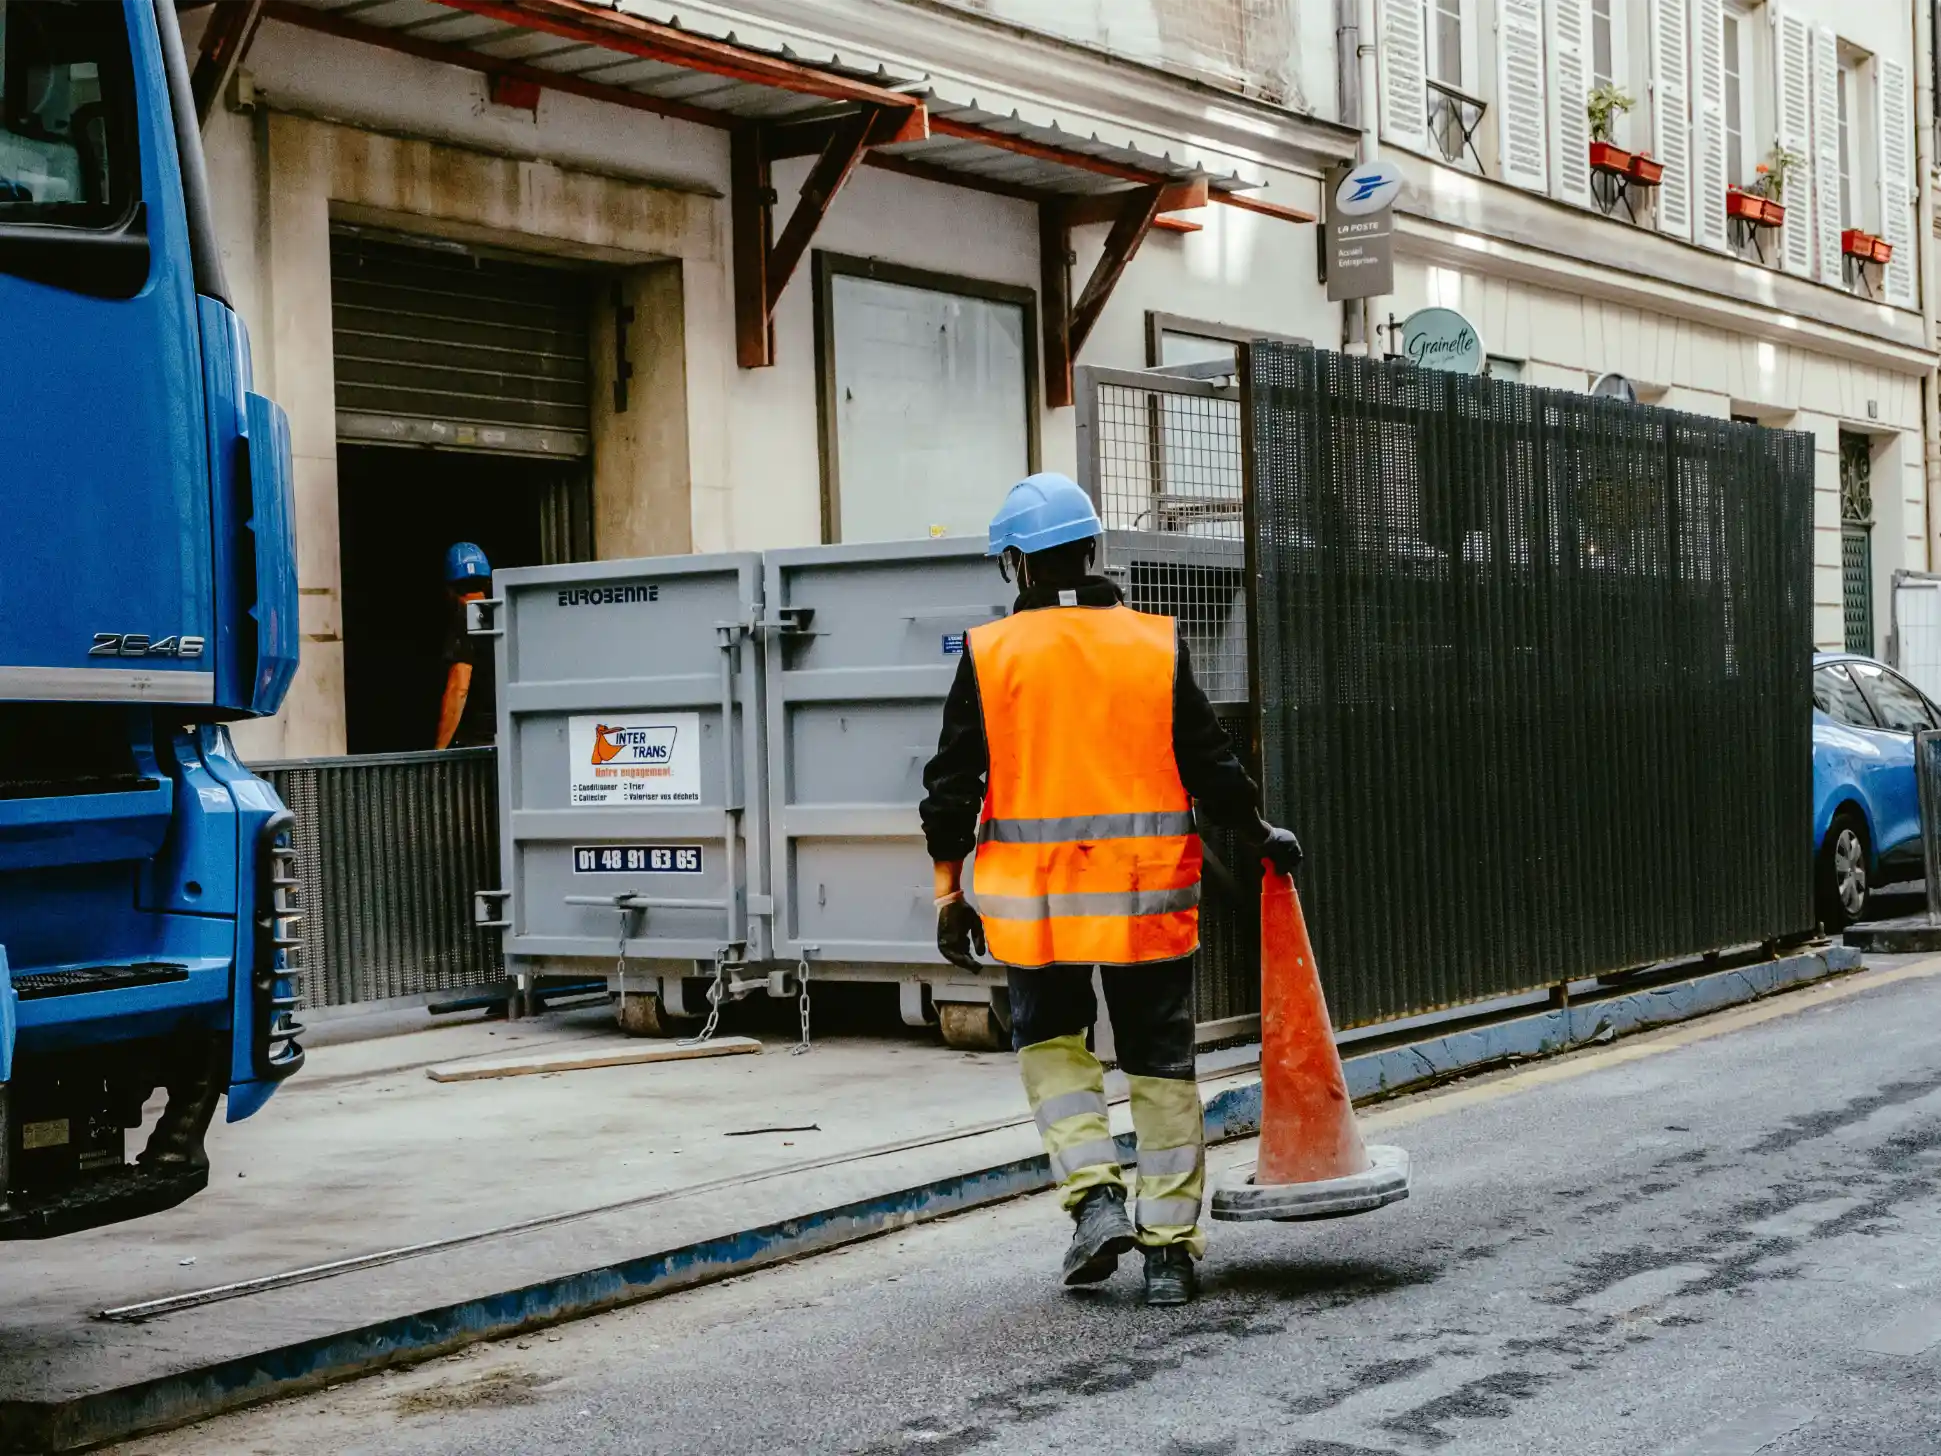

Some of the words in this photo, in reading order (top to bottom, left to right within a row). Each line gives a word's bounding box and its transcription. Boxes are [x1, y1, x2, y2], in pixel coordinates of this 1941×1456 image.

[1337, 226, 1349, 234] LA
[1350, 222, 1379, 232] POSTE
[1408, 328, 1474, 364] Grainette
[558, 584, 659, 606] EUROBENNE
[88, 632, 205, 657] 2646
[615, 732, 646, 744] INTER
[632, 745, 667, 758] TRANS
[595, 767, 618, 777] Notre
[578, 783, 618, 791] Conditionner
[578, 794, 608, 802] Collecter
[629, 793, 659, 801] Valoriser
[673, 792, 699, 801] déchets
[579, 850, 596, 870] 01
[601, 850, 622, 869] 48
[627, 850, 645, 869] 91
[651, 849, 672, 869] 63
[676, 849, 697, 869] 65
